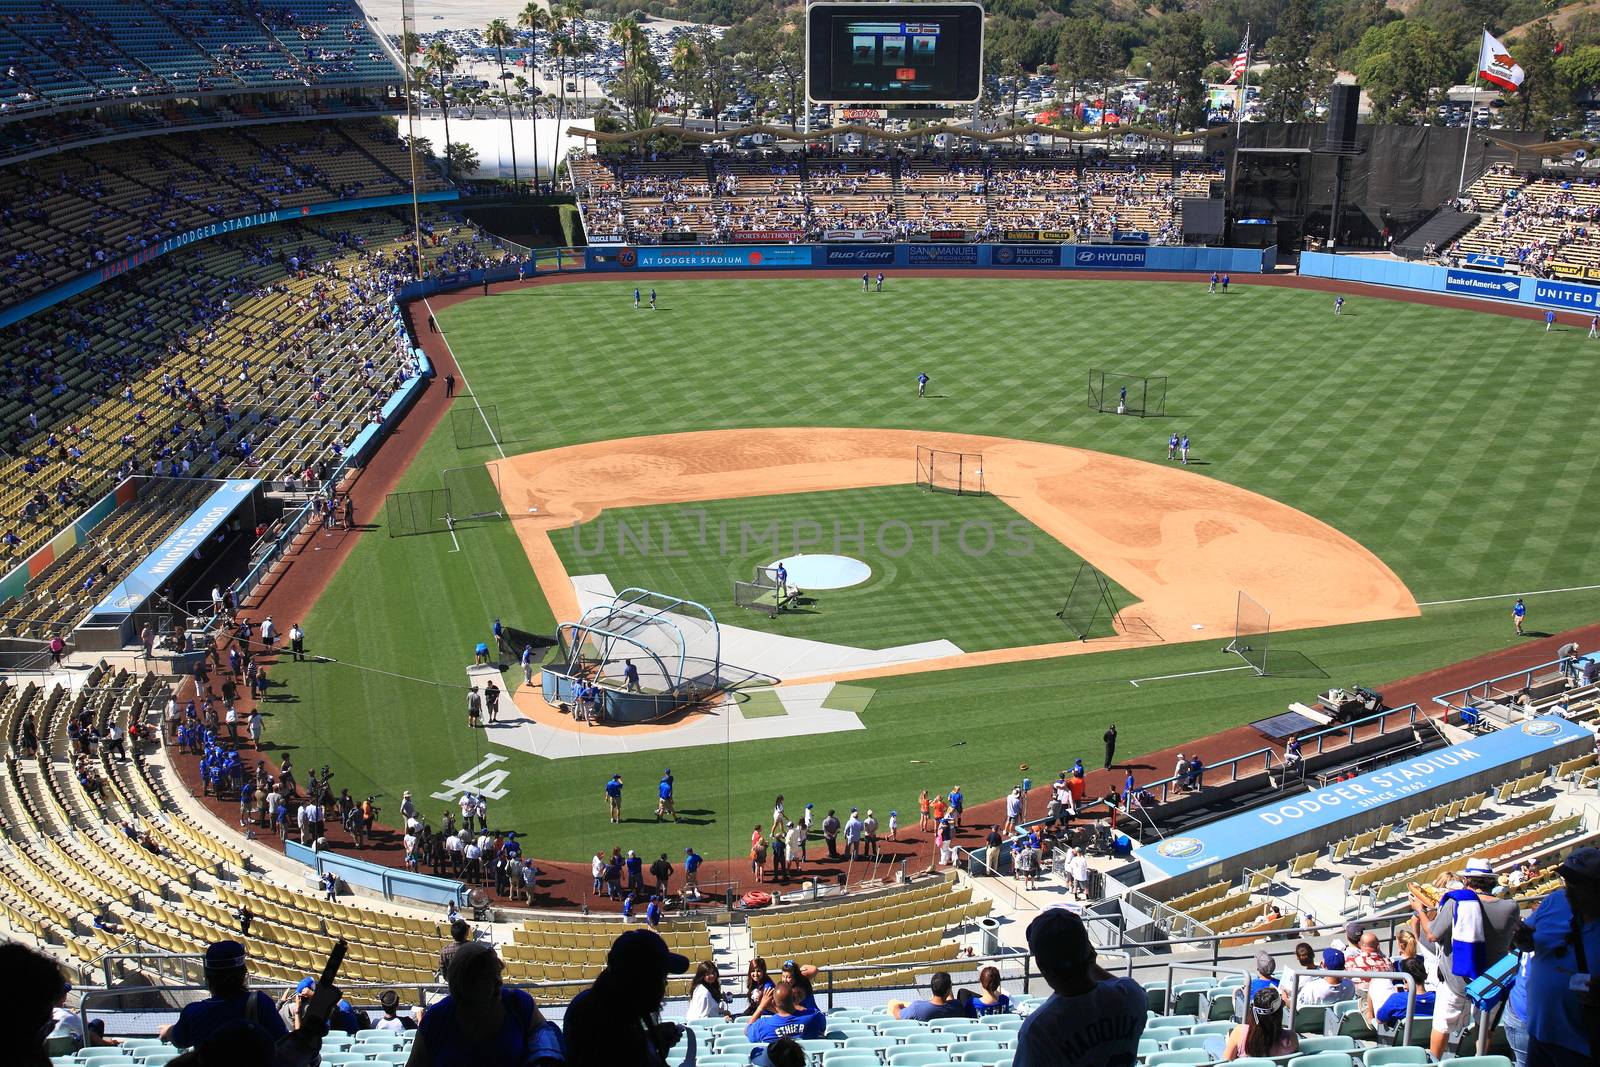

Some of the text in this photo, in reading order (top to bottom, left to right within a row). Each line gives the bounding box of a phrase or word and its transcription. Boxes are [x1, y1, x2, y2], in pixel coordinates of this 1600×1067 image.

[163, 239, 174, 253] AT
[177, 224, 217, 247] DODGER
[222, 211, 279, 232] STADIUM
[622, 252, 634, 262] 76
[858, 250, 892, 259] LIGHT
[910, 247, 976, 255] SAN MANUEL
[643, 257, 653, 265] AT
[1098, 254, 1144, 262] HYUNDAI
[1448, 277, 1465, 286] Bank
[1473, 280, 1501, 290] America
[1537, 288, 1593, 303] UNITED
[1259, 748, 1481, 825] DODGER STADIUM
[1361, 781, 1426, 807] SINCE 1962
[775, 1023, 805, 1037] ETHIER
